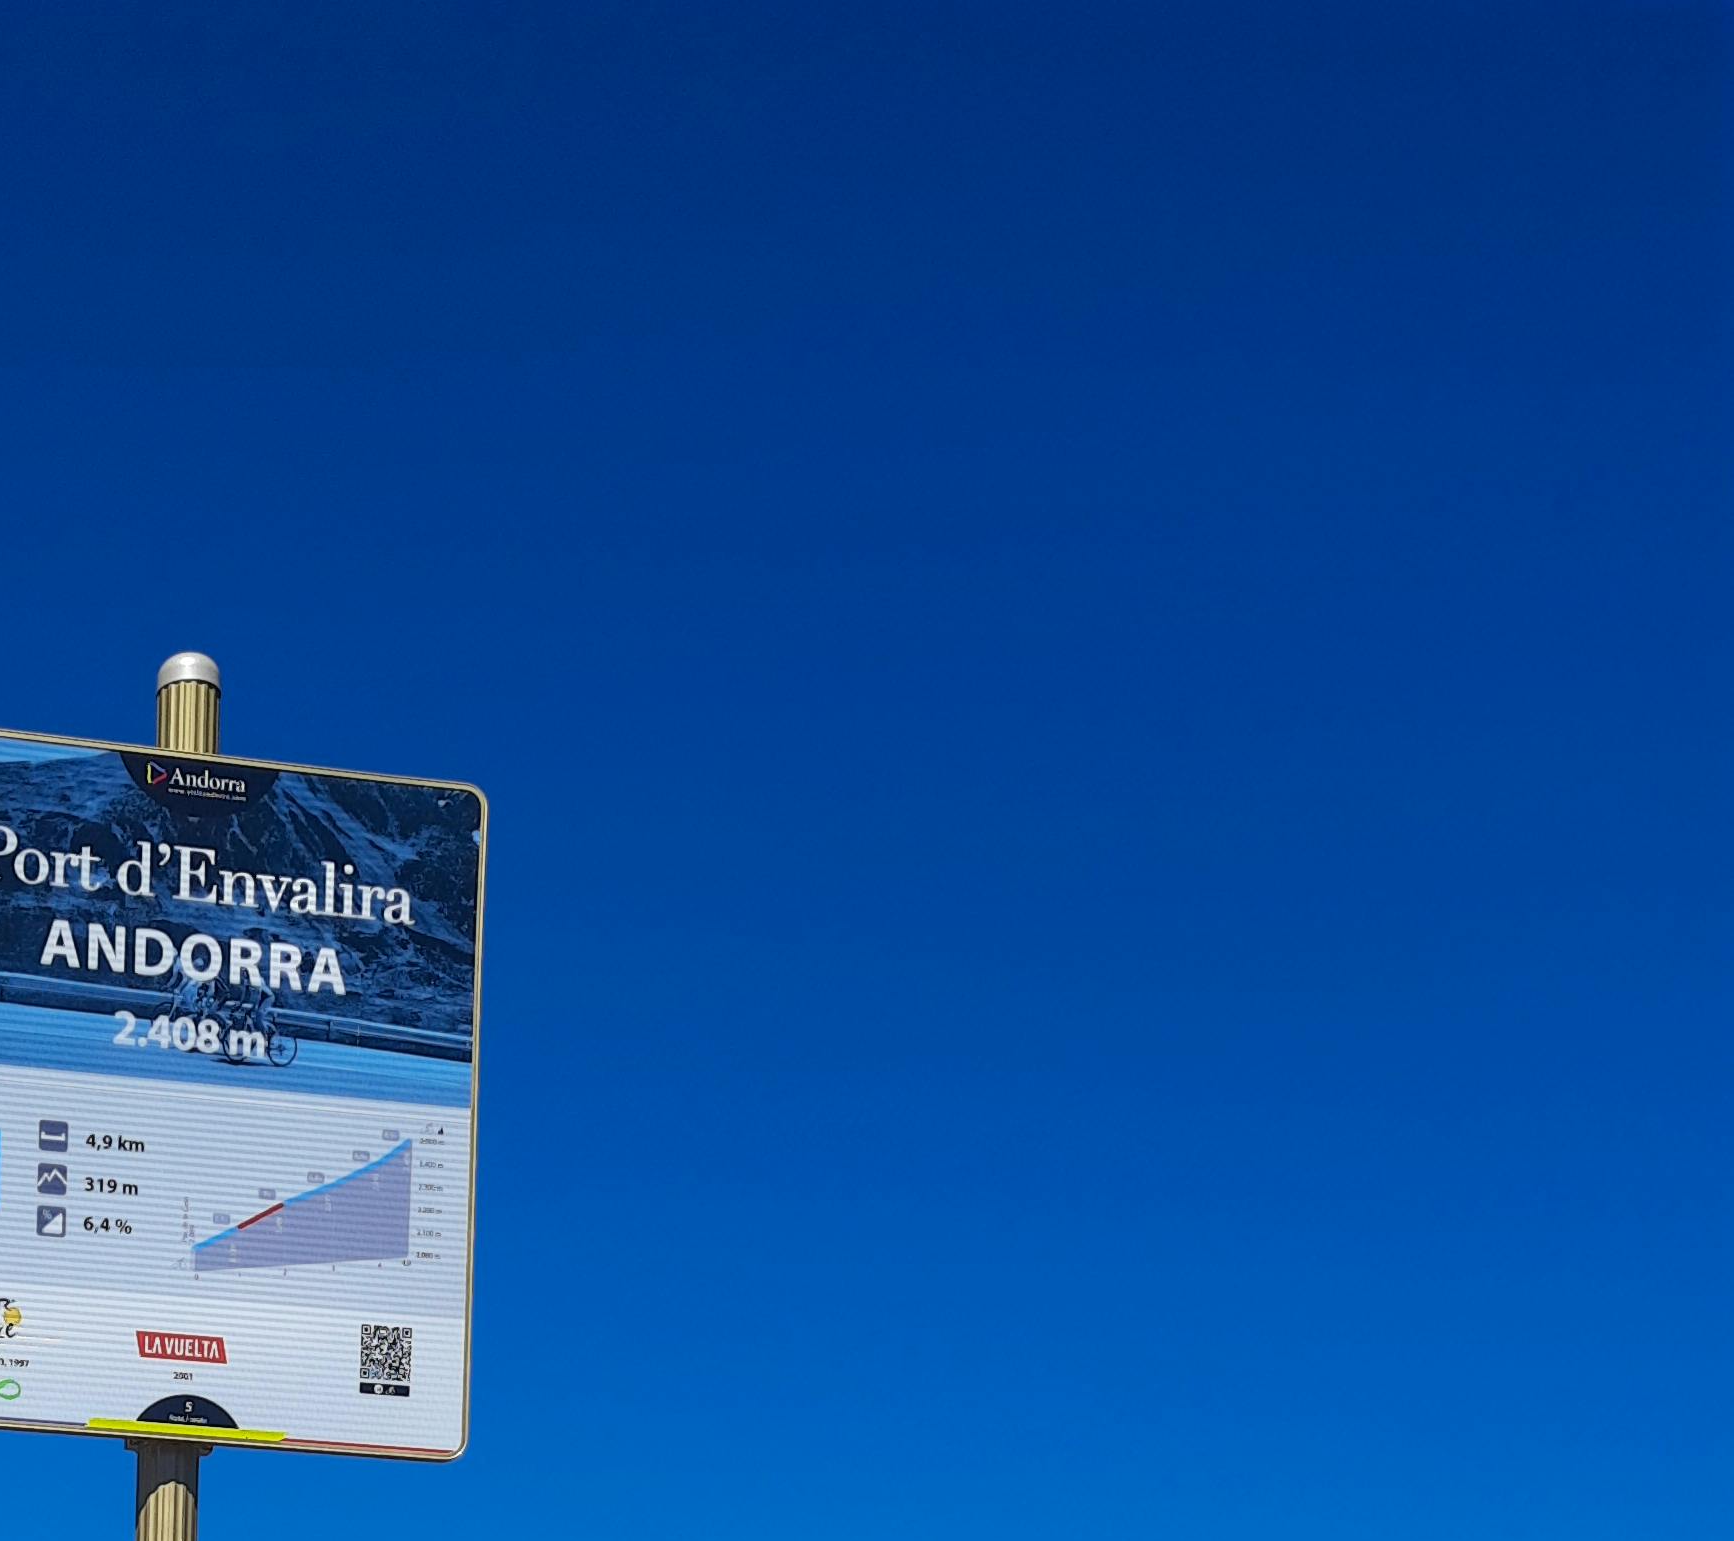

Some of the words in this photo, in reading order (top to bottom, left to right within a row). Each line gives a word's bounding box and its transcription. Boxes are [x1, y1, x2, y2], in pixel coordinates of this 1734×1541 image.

[168, 767, 246, 793] Andorra
[117, 840, 416, 926] d'Envalira
[39, 918, 347, 996] ANDORRA
[112, 1010, 222, 1054] 2.408
[229, 1031, 266, 1058] m
[85, 1134, 113, 1151] 4,9
[118, 1135, 145, 1153] km
[84, 1177, 118, 1194] 319
[122, 1183, 139, 1196] m
[83, 1216, 111, 1234] 6,4
[115, 1218, 133, 1235] %
[144, 1335, 163, 1355] LA
[164, 1337, 220, 1360] VUELTA
